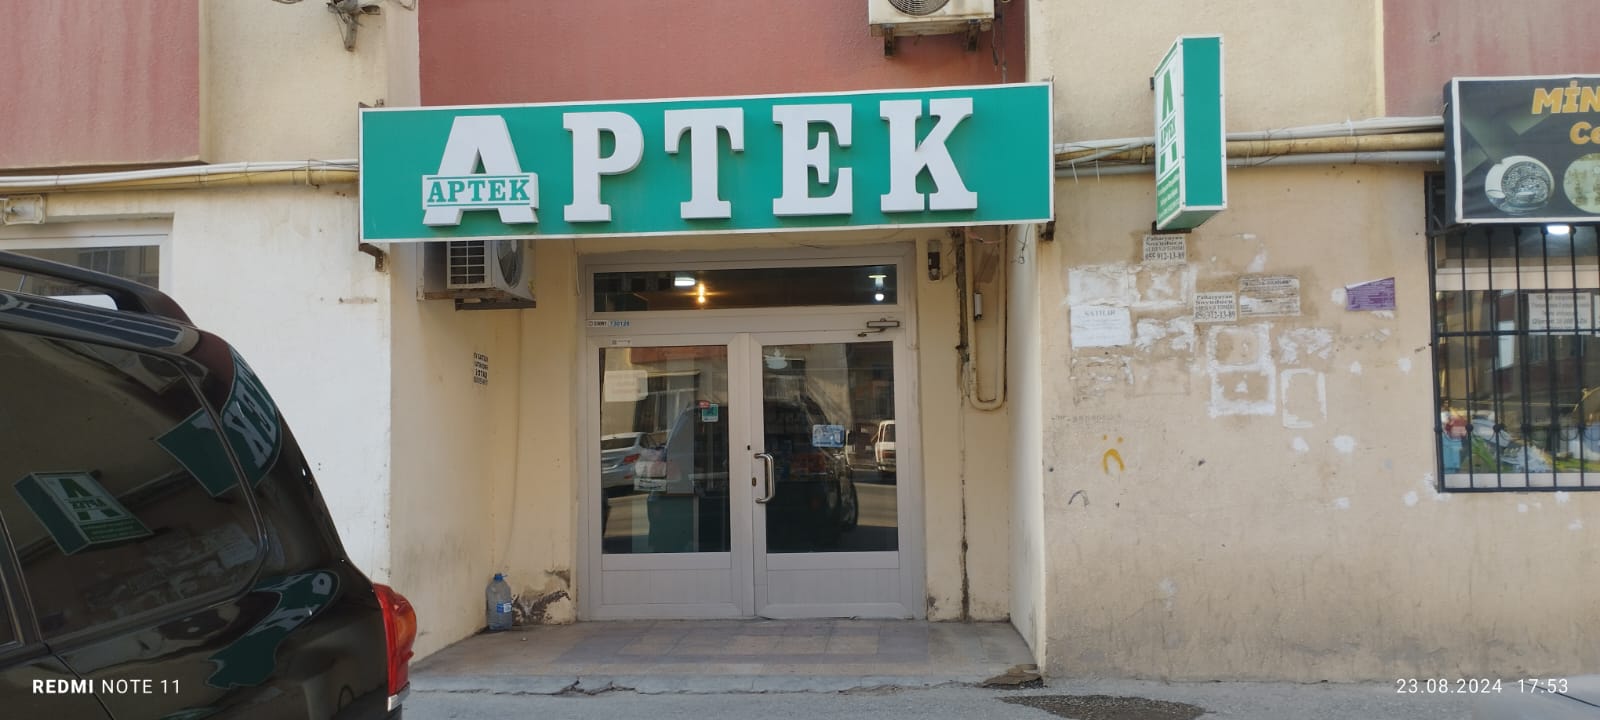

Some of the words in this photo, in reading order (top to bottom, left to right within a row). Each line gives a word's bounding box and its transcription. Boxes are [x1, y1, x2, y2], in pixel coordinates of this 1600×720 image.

[1160, 117, 1176, 149] APTEK
[422, 97, 978, 226] APTEK
[427, 178, 530, 204] APTEK
